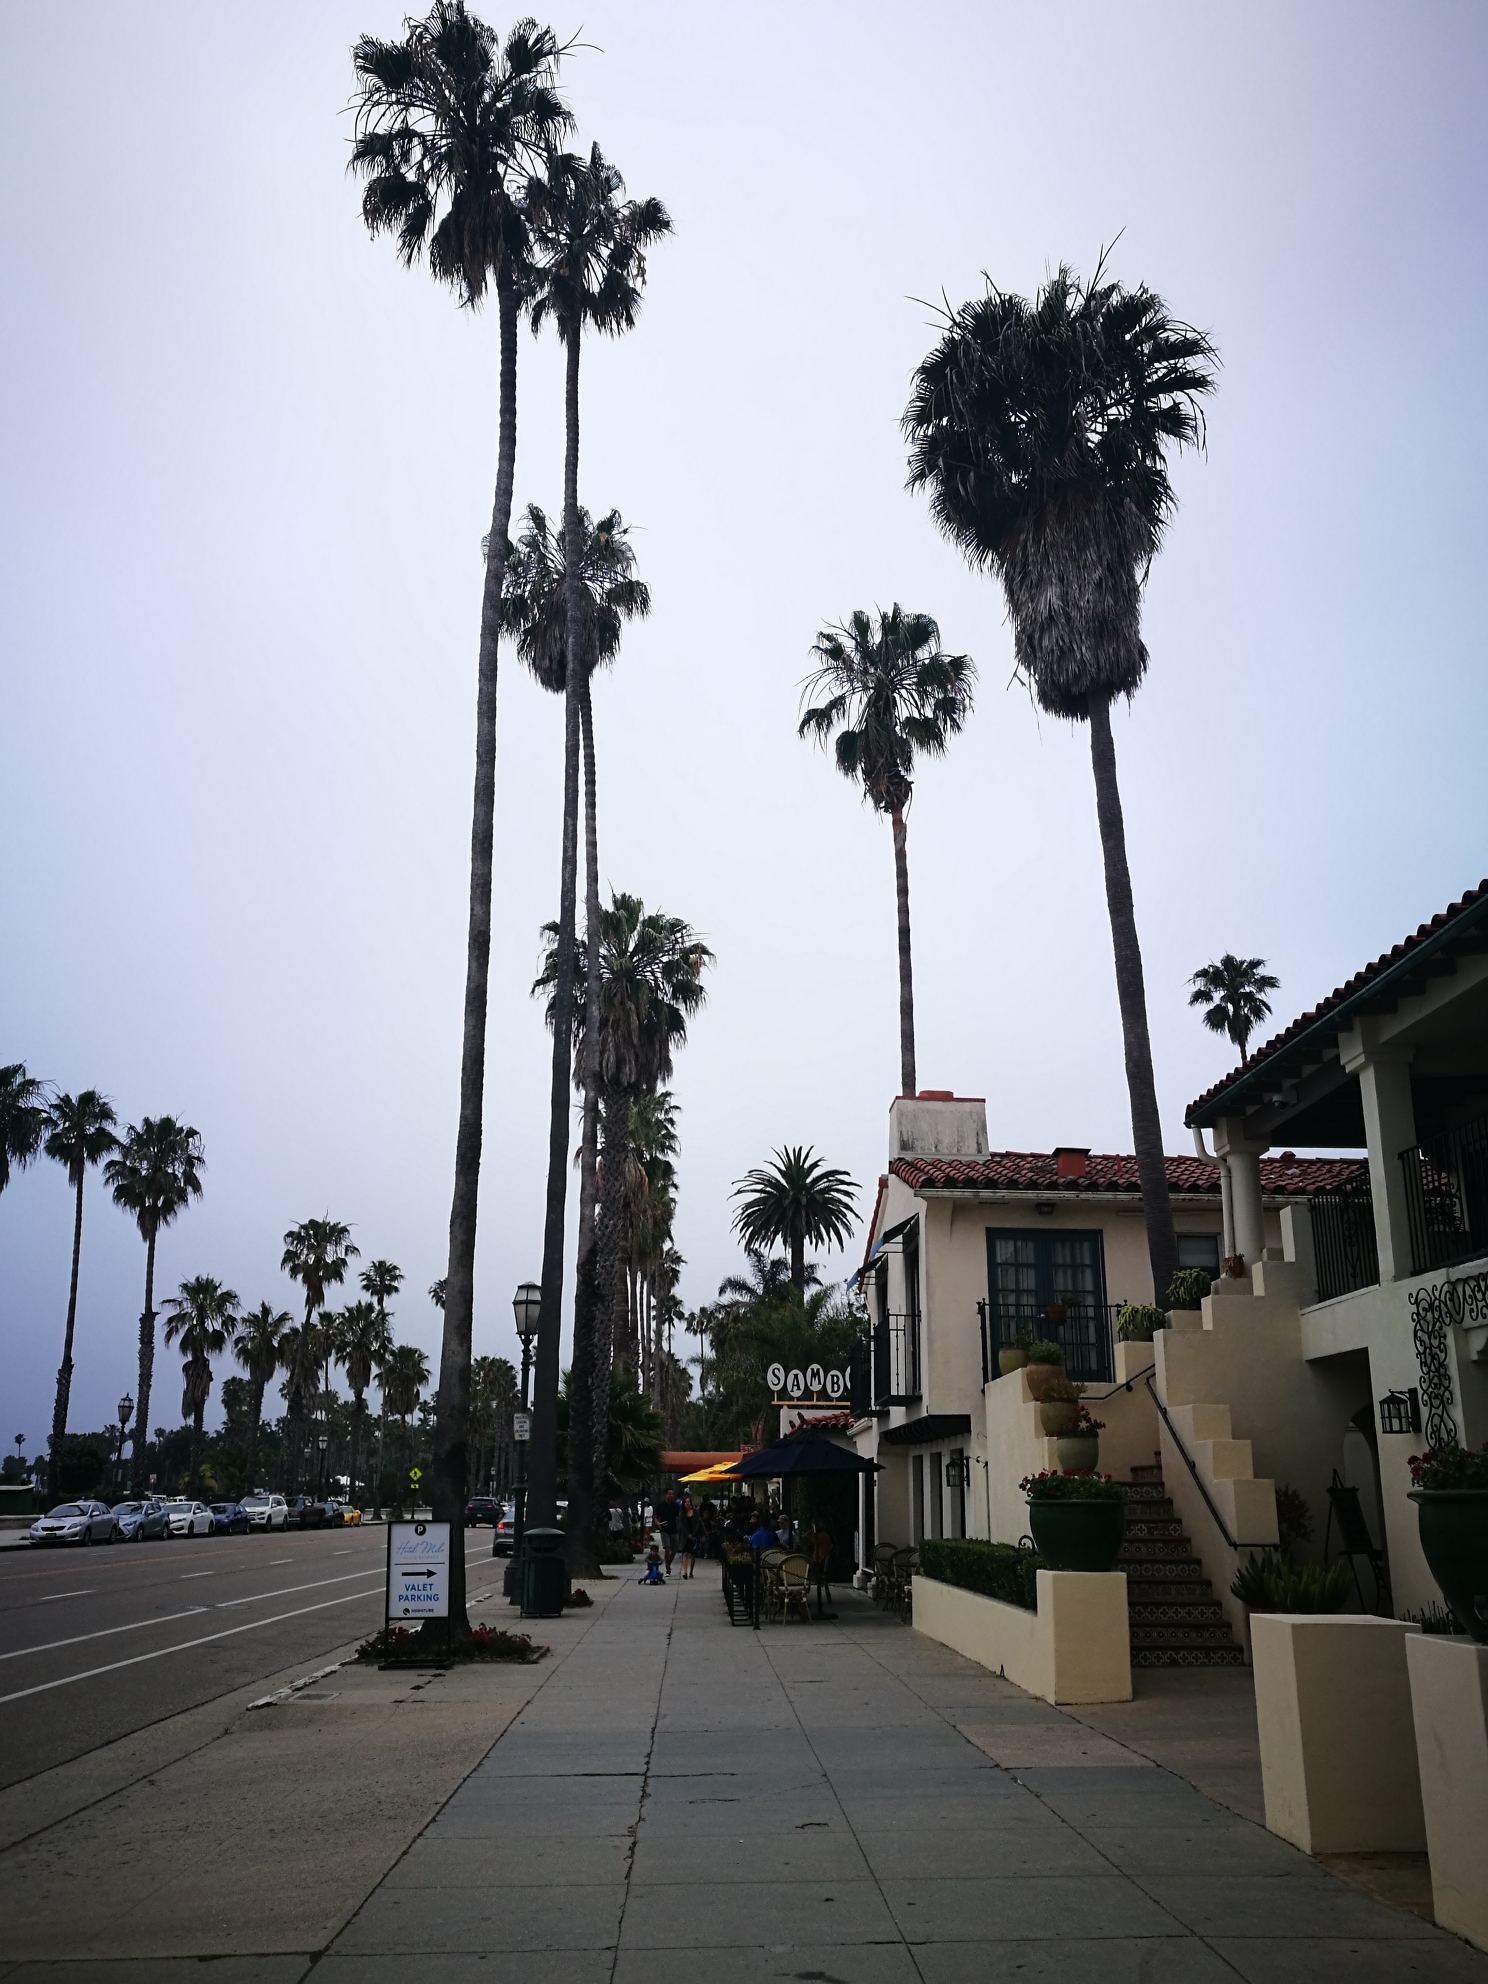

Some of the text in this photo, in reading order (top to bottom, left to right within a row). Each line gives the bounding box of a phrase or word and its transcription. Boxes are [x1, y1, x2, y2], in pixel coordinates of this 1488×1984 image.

[771, 1367, 850, 1393] SAMB
[396, 1540, 419, 1555] Hotel
[404, 1583, 434, 1592] VALET
[398, 1593, 440, 1603] PARKING
